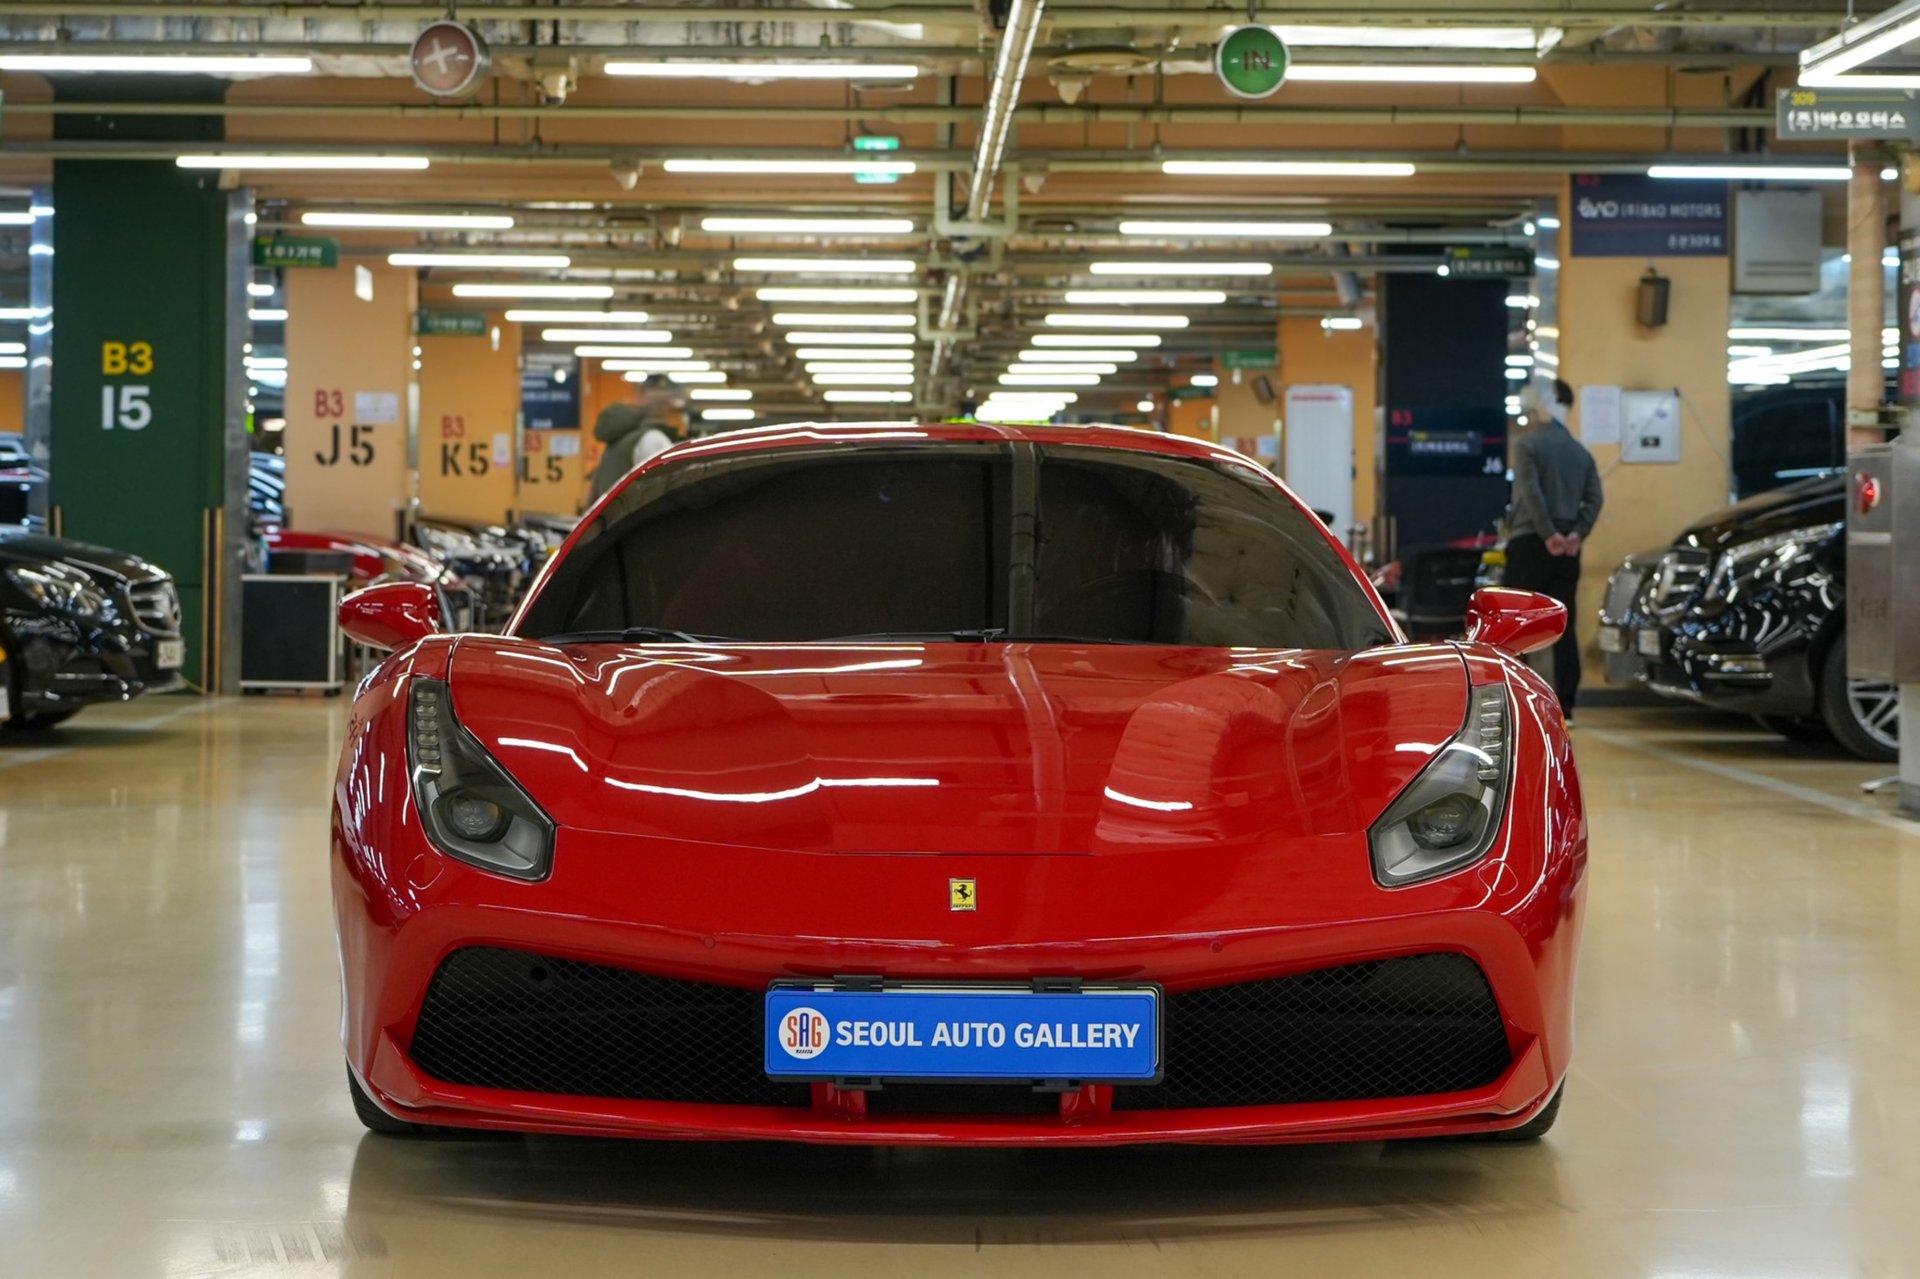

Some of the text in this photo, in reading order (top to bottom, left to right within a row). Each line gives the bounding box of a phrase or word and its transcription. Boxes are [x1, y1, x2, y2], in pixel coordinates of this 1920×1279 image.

[1243, 49, 1270, 72] IN
[1788, 110, 1905, 132] (주)바오모터스
[1669, 203, 1722, 218] MOTORS
[103, 341, 154, 376] B3
[315, 389, 344, 418] B3
[442, 415, 465, 438] B3
[441, 443, 489, 476] K5
[1483, 457, 1503, 474] J6
[787, 1013, 822, 1048] SAG
[836, 1021, 1140, 1049] SEOUL AUTO GALLERY
